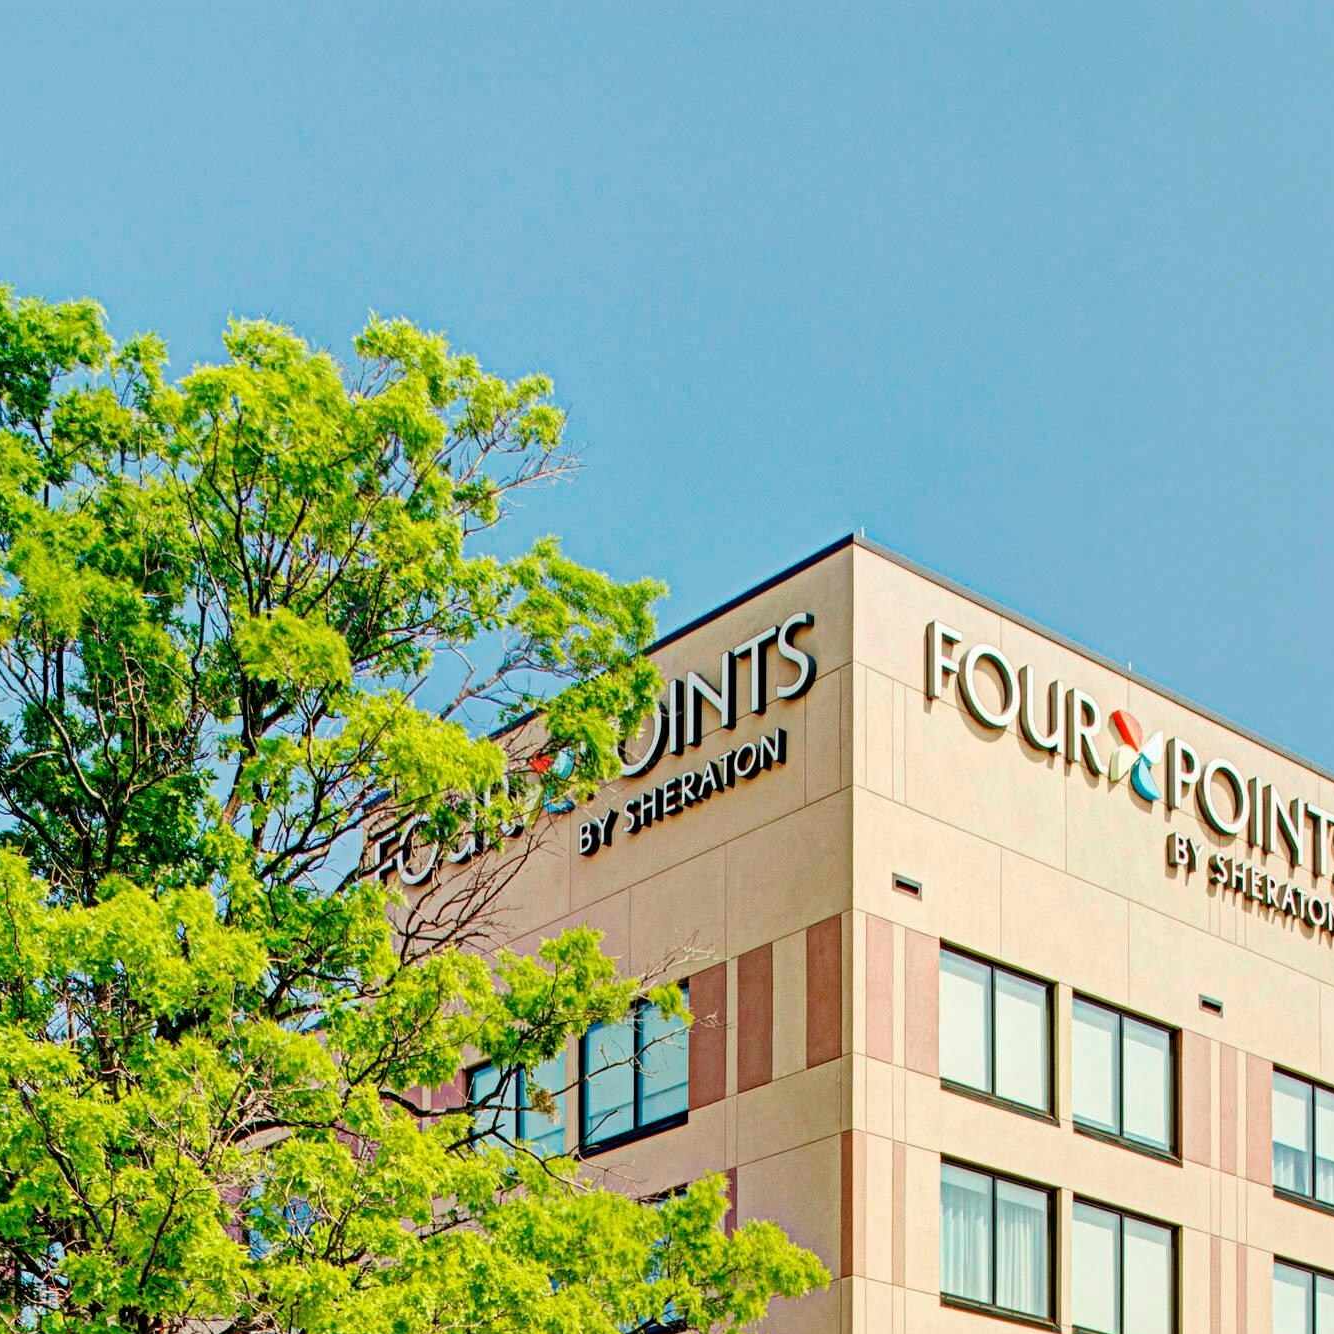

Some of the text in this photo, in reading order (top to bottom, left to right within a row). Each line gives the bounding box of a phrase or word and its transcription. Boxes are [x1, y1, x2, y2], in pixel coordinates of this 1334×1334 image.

[579, 612, 816, 778] OINTS
[924, 619, 1110, 774] FOUR
[579, 727, 786, 855] BY SHERATON
[1168, 831, 1204, 873] BY
